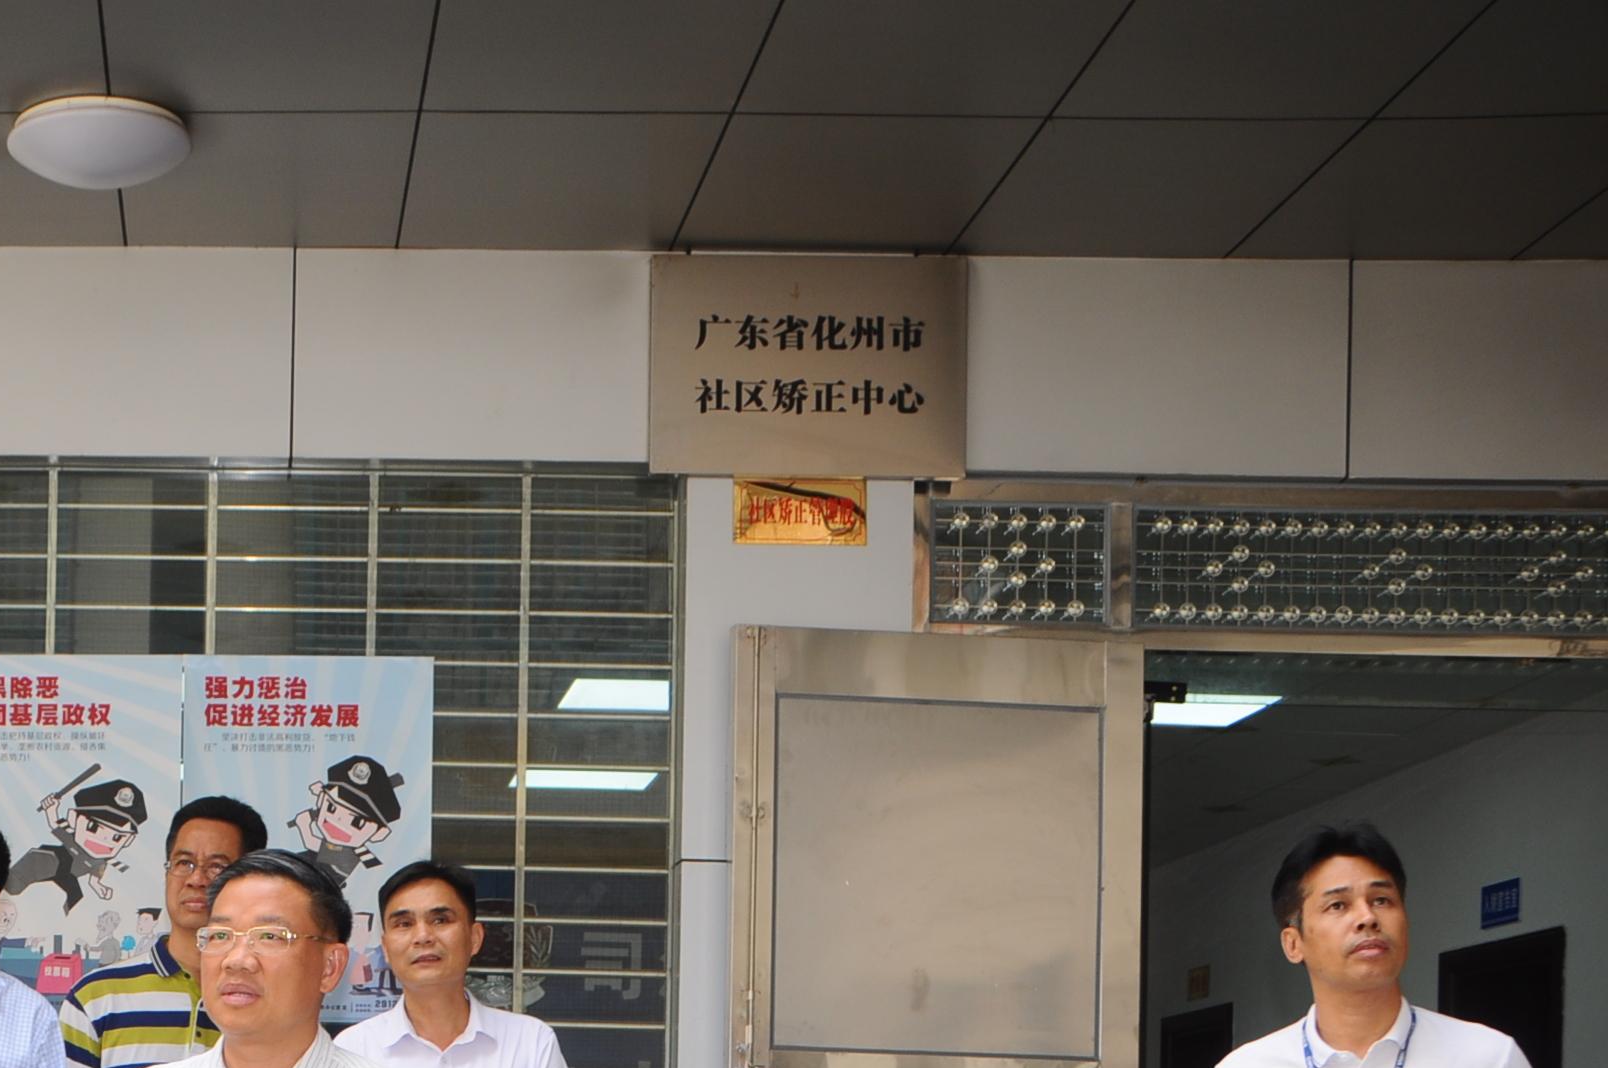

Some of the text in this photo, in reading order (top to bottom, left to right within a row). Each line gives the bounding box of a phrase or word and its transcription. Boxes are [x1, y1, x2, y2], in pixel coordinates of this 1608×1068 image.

[694, 314, 925, 352] 广东省化州市
[695, 378, 924, 415] 社区矫正中心
[205, 676, 307, 700] 强力惩治
[204, 703, 359, 727] 促进经济发展
